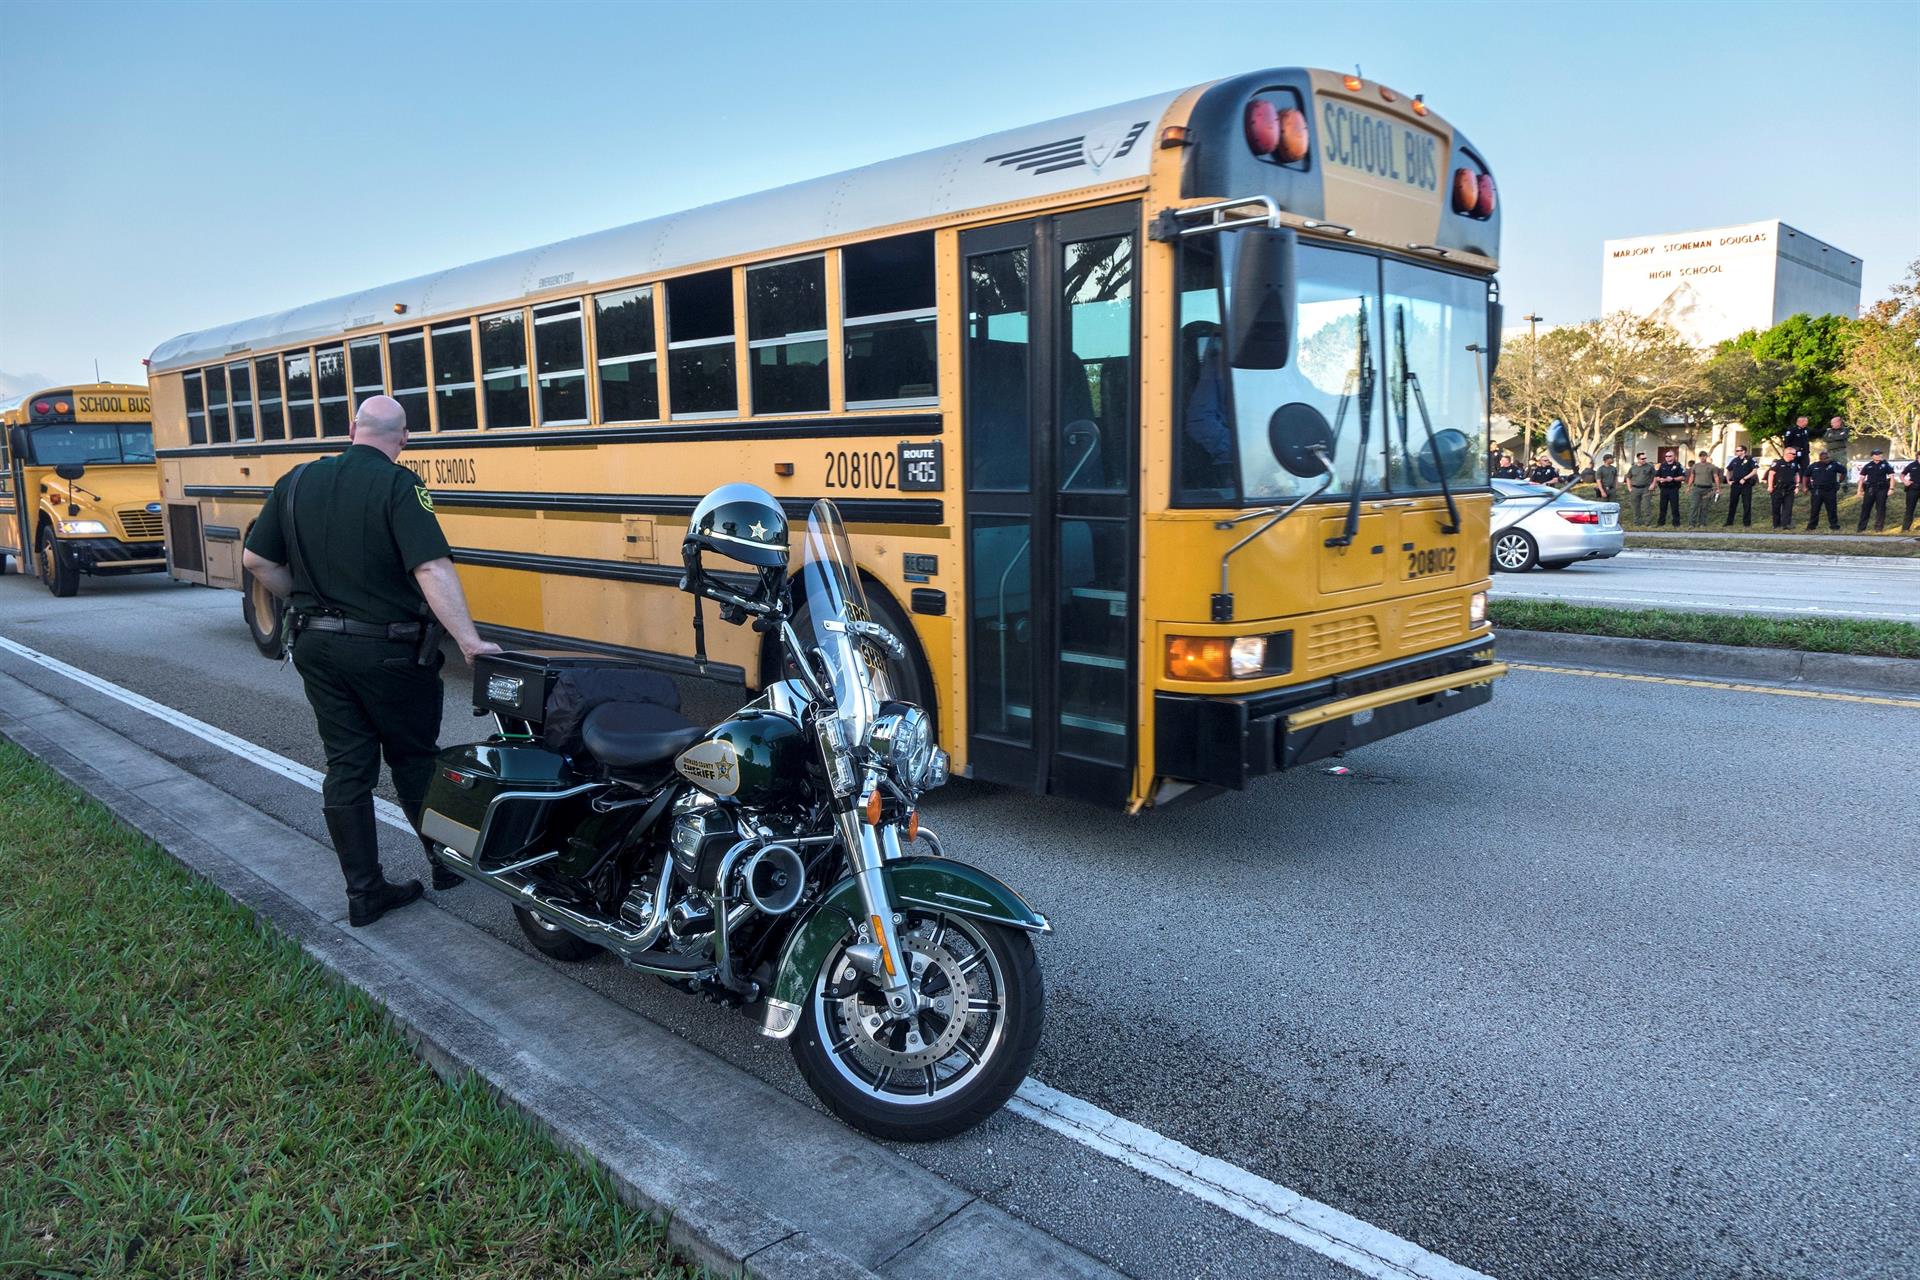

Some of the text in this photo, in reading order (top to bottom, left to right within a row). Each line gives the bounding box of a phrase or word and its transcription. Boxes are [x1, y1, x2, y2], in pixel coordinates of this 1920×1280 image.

[1323, 101, 1438, 191] SCHOOL BUS
[1613, 233, 1767, 258] MARJORY STONEMAN DOUGLAS
[1649, 264, 1723, 279] HIGH SCHOOL
[80, 396, 150, 413] SCHOOL BUS
[903, 449, 935, 458] ROUTE
[435, 458, 476, 484] SCHOOLS
[825, 451, 896, 489] 208102
[1408, 547, 1456, 578] 208102
